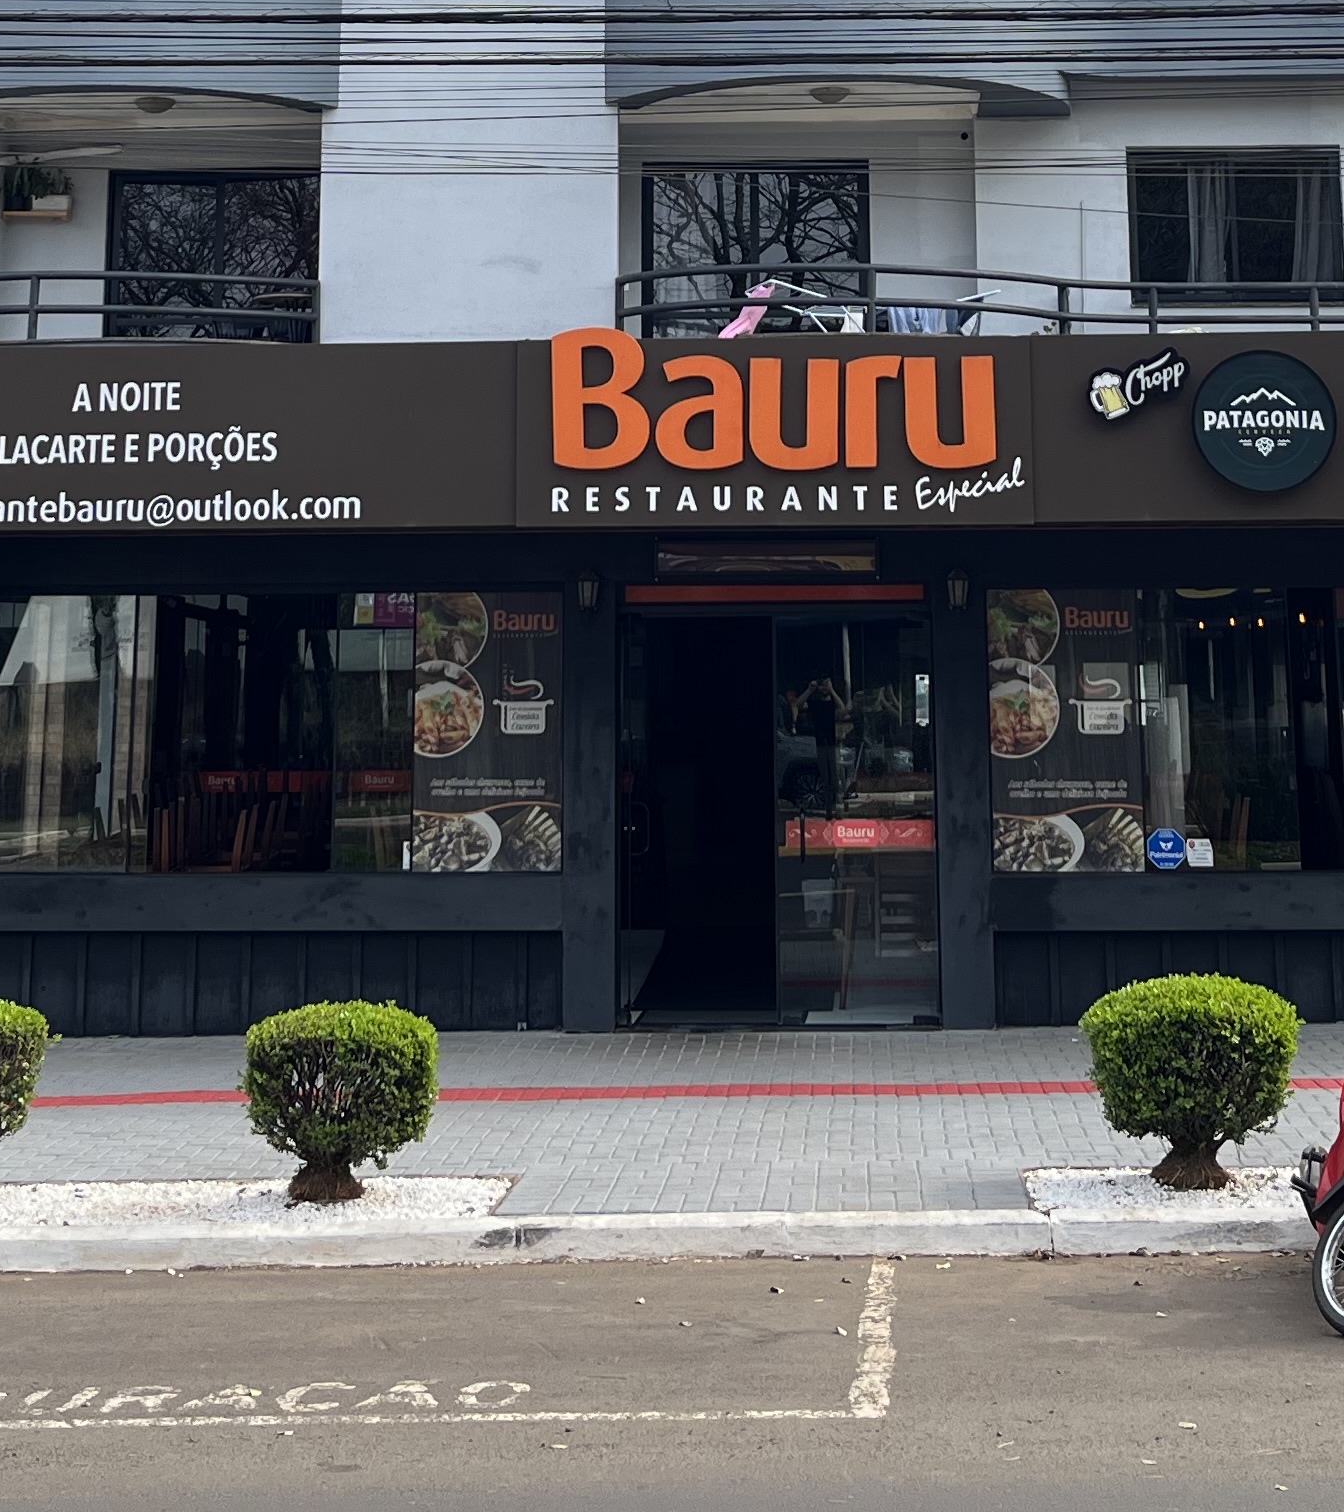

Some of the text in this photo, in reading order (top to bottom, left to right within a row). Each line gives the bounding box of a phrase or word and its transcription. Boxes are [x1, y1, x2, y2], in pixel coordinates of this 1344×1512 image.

[1125, 351, 1185, 406] Chopp
[72, 381, 182, 412] A NOITE
[550, 326, 997, 470] Bauru
[1203, 409, 1325, 432] PATAGONIA
[124, 433, 140, 463] E
[147, 426, 278, 471] PORÇÕES
[551, 456, 1027, 513] RESTAURANTE Especial
[492, 610, 556, 631] Bauru
[1064, 607, 1129, 628] Bauru
[365, 774, 395, 785] Bauru
[837, 825, 875, 838] Bauru
